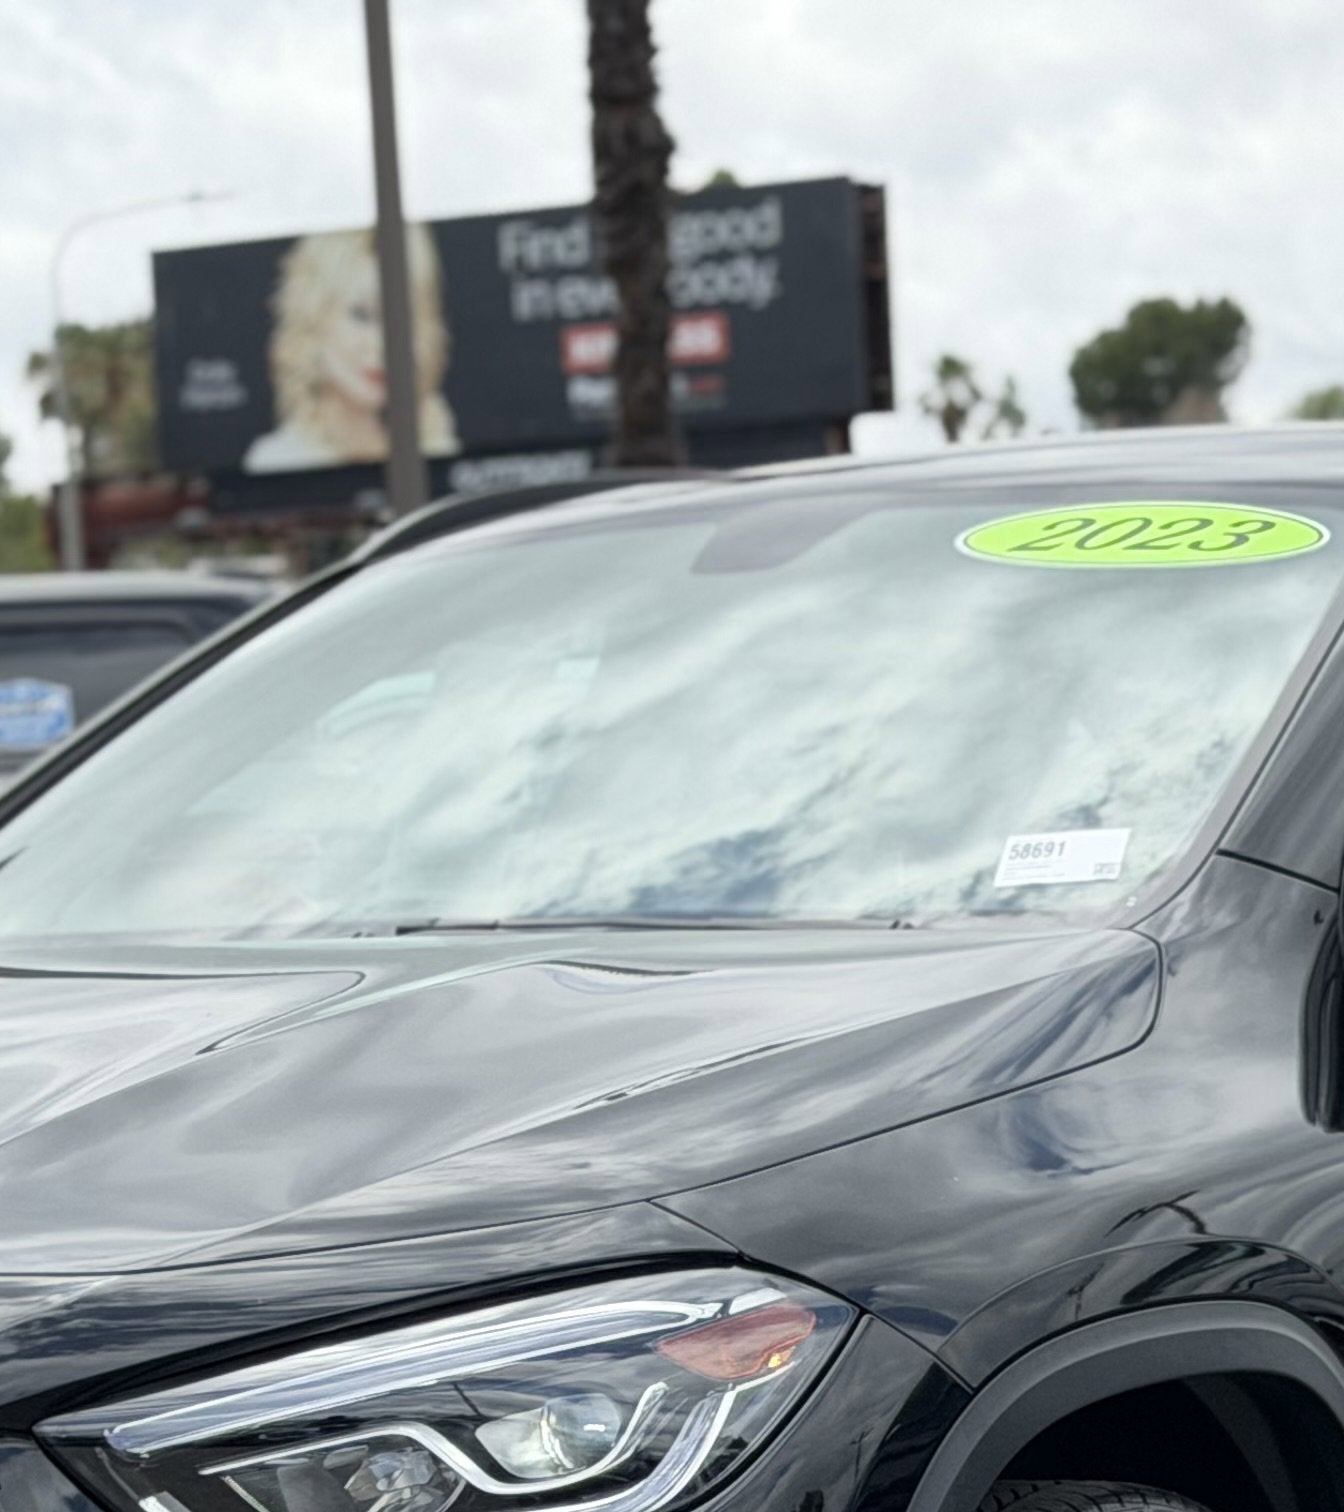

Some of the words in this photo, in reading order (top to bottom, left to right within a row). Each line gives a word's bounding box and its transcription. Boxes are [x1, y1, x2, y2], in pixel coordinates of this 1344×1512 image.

[498, 221, 590, 272] Find
[666, 198, 781, 263] good
[1007, 517, 1276, 552] 2023
[1008, 841, 1068, 860] 58691
